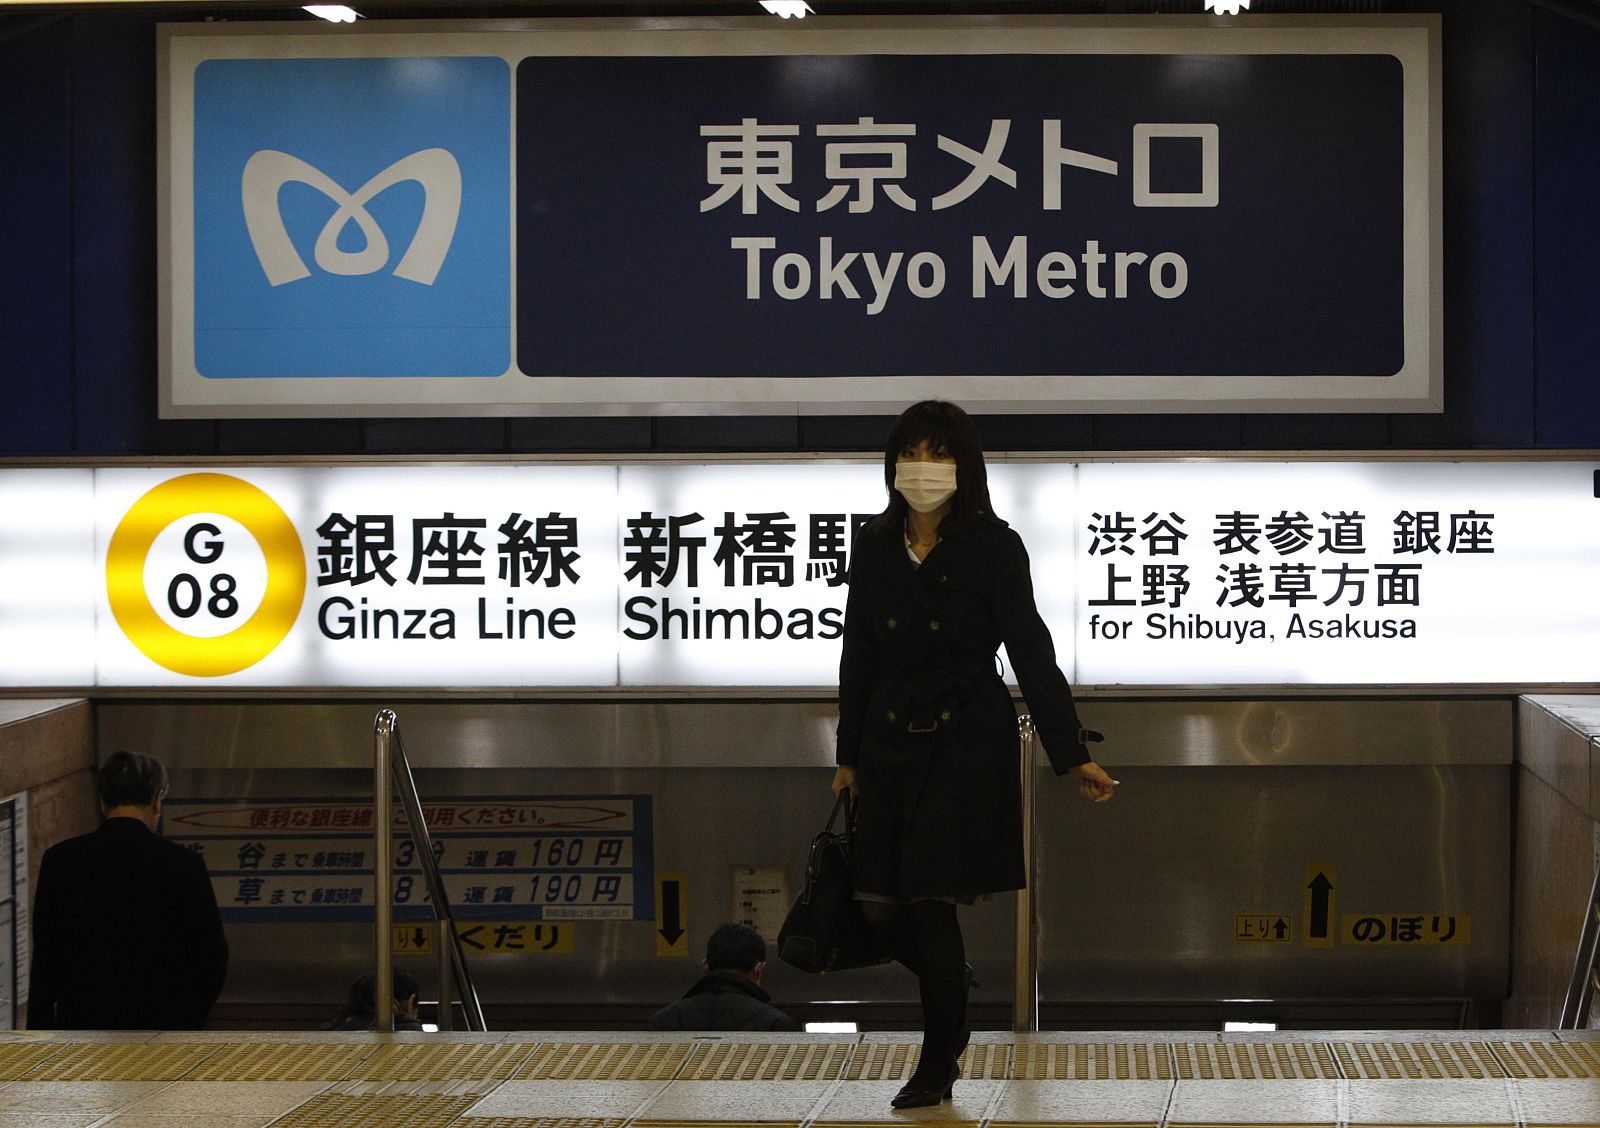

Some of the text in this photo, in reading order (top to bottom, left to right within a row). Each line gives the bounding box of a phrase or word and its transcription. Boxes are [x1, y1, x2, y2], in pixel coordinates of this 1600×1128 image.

[700, 116, 1220, 215] 東京メトロ
[731, 235, 1189, 315] Tokyo Metro
[184, 522, 225, 564] G
[316, 511, 581, 588] 銀座線
[1088, 510, 1495, 556] 渋谷 表参道 銀座
[167, 572, 239, 619] 08
[1088, 562, 1423, 609] 上野 浅草方面
[318, 595, 456, 640] Ginza
[479, 596, 577, 640] Line
[1089, 613, 1417, 644] for Shibuya, Asakusa
[459, 924, 559, 950] くだり
[1238, 918, 1269, 939] 上り
[1352, 915, 1456, 943] のぼり
